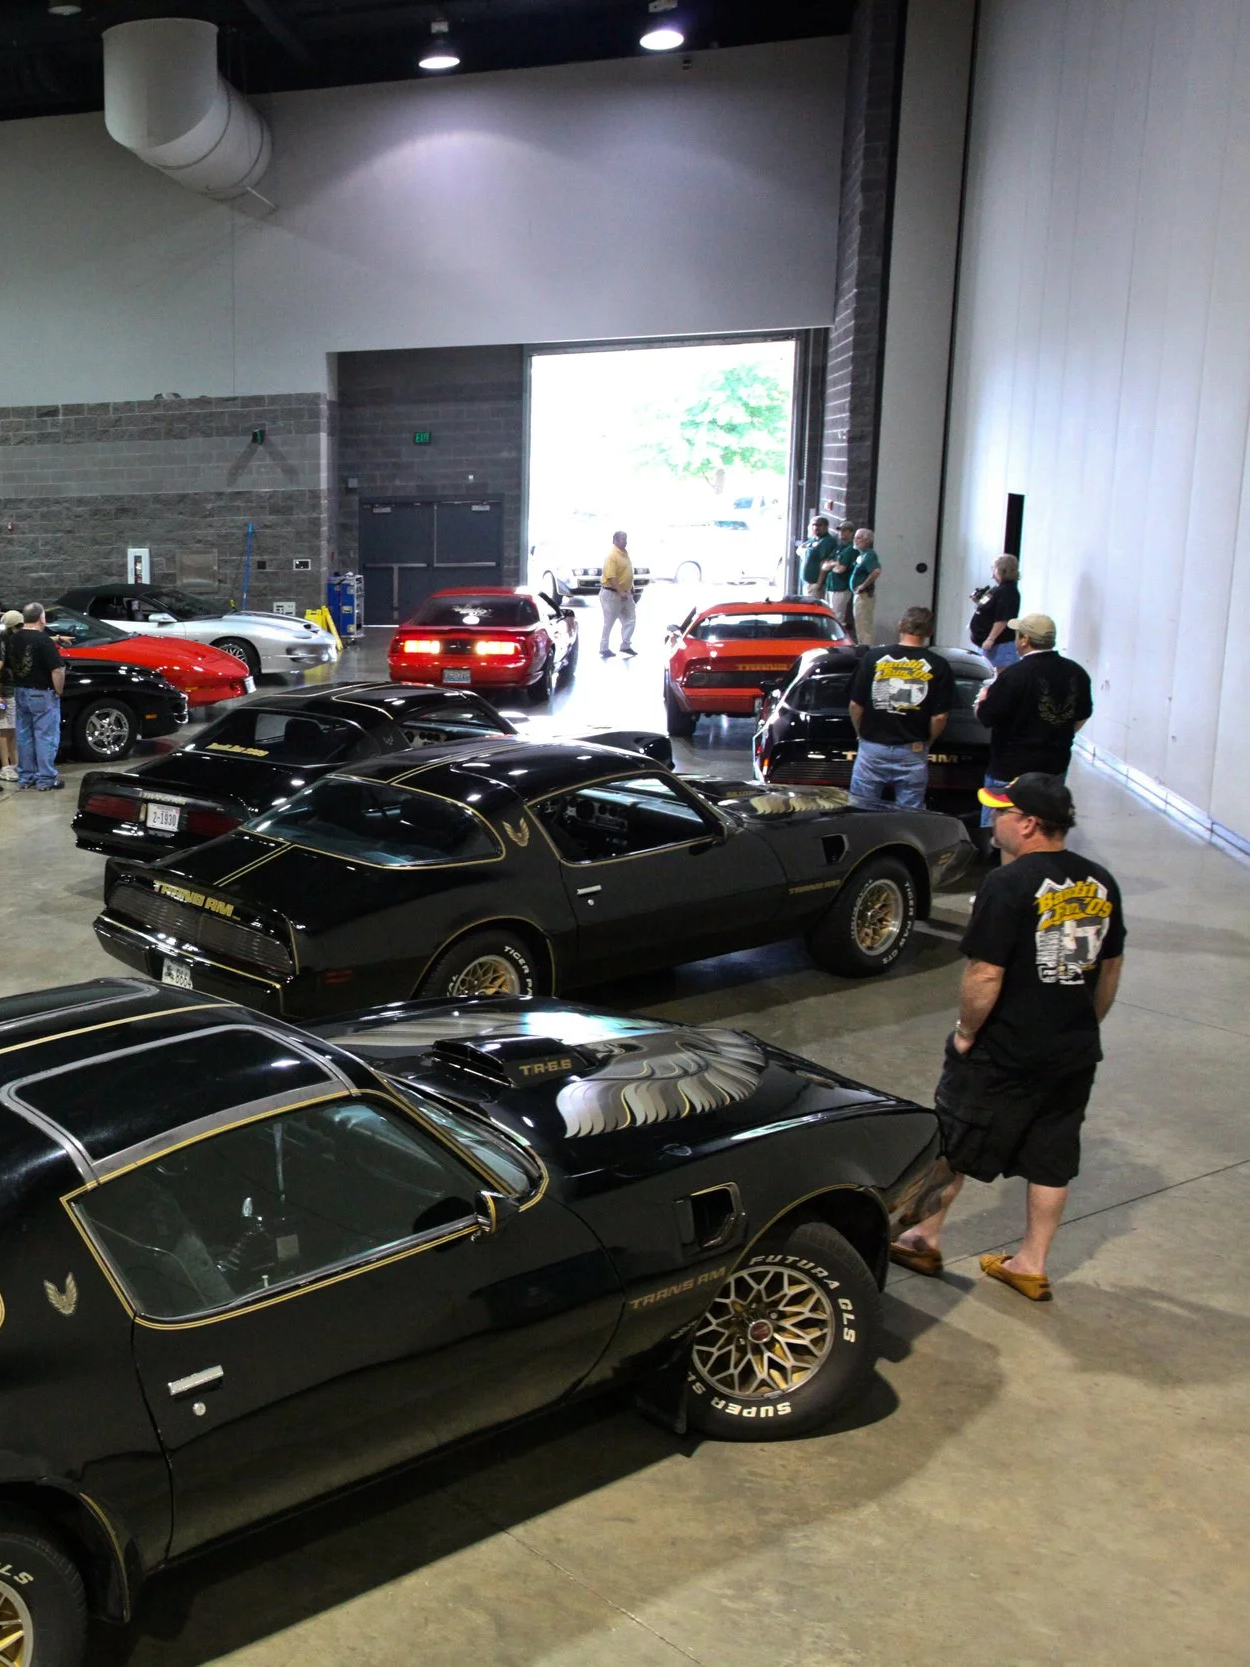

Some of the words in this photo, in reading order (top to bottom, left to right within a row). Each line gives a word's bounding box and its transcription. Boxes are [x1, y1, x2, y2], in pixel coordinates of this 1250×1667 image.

[153, 880, 205, 906] TRANS
[204, 897, 235, 917] AM
[1038, 881, 1099, 914] Bandit
[504, 946, 530, 974] TIGER
[630, 1279, 694, 1309] TRANS
[698, 1266, 726, 1285] AM
[748, 1255, 841, 1290] FUTURA
[837, 1298, 857, 1344] GLS
[710, 1397, 792, 1418] SUPER
